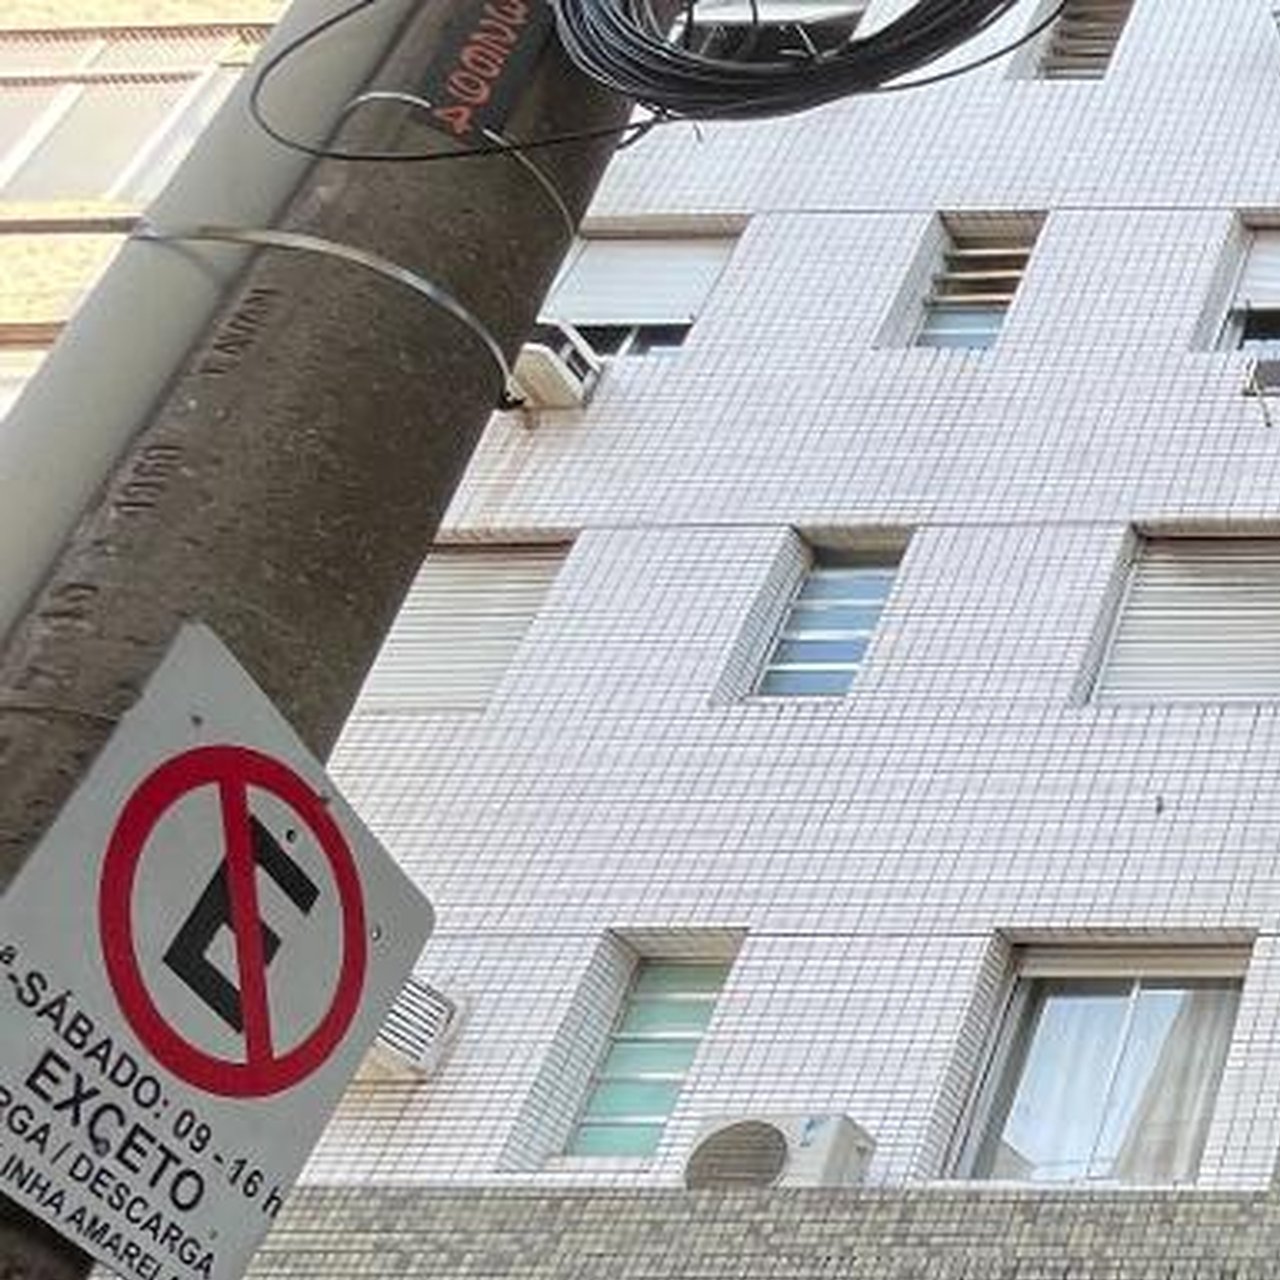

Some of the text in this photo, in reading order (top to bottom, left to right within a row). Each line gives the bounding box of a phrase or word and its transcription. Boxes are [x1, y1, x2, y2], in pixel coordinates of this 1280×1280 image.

[24, 1048, 207, 1213] EXCETO
[176, 1107, 213, 1153] 09
[227, 1155, 263, 1199] 16
[264, 1190, 285, 1218] h
[68, 1152, 217, 1280] DESCARGA
